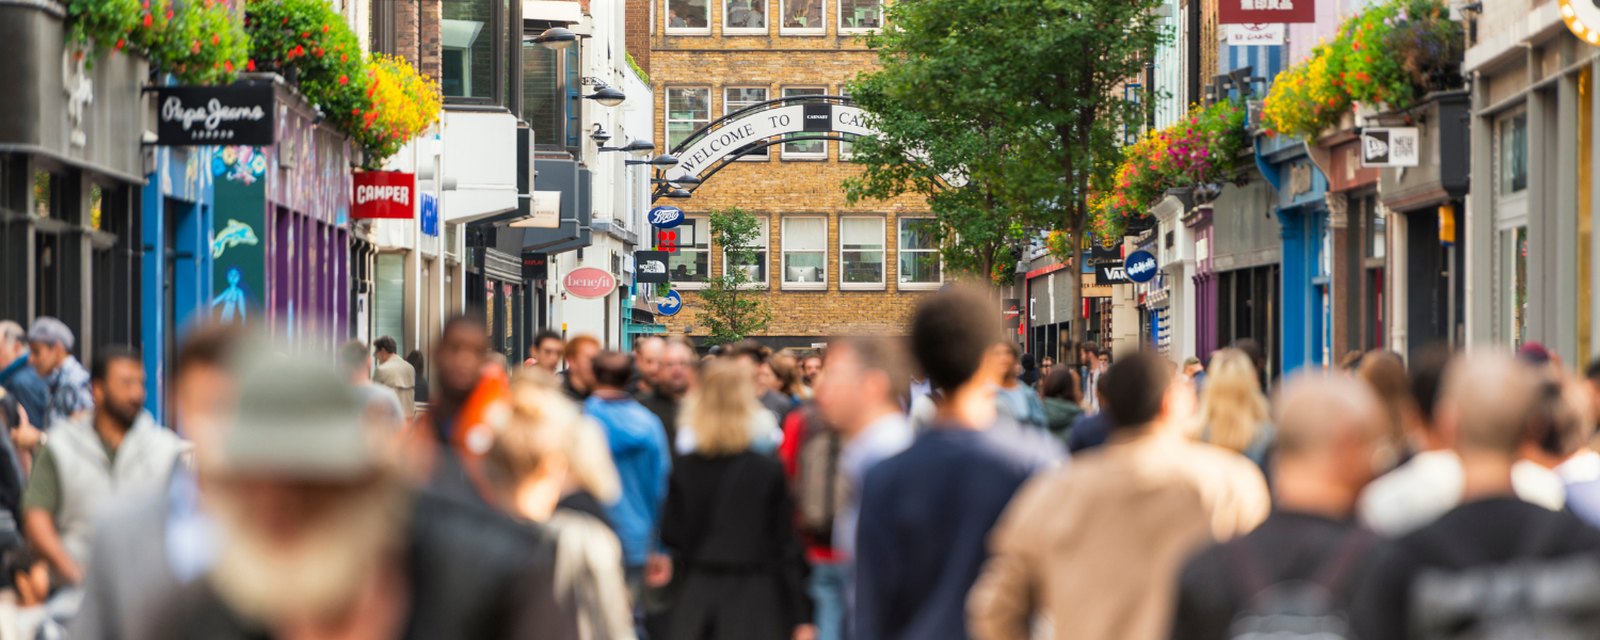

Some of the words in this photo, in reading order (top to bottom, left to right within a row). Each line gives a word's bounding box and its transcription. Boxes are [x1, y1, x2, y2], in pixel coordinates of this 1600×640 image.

[681, 123, 755, 173] WELCOME
[768, 114, 790, 129] TO
[357, 185, 409, 206] CAMPER
[651, 209, 680, 224] Boots
[567, 275, 610, 290] benefit
